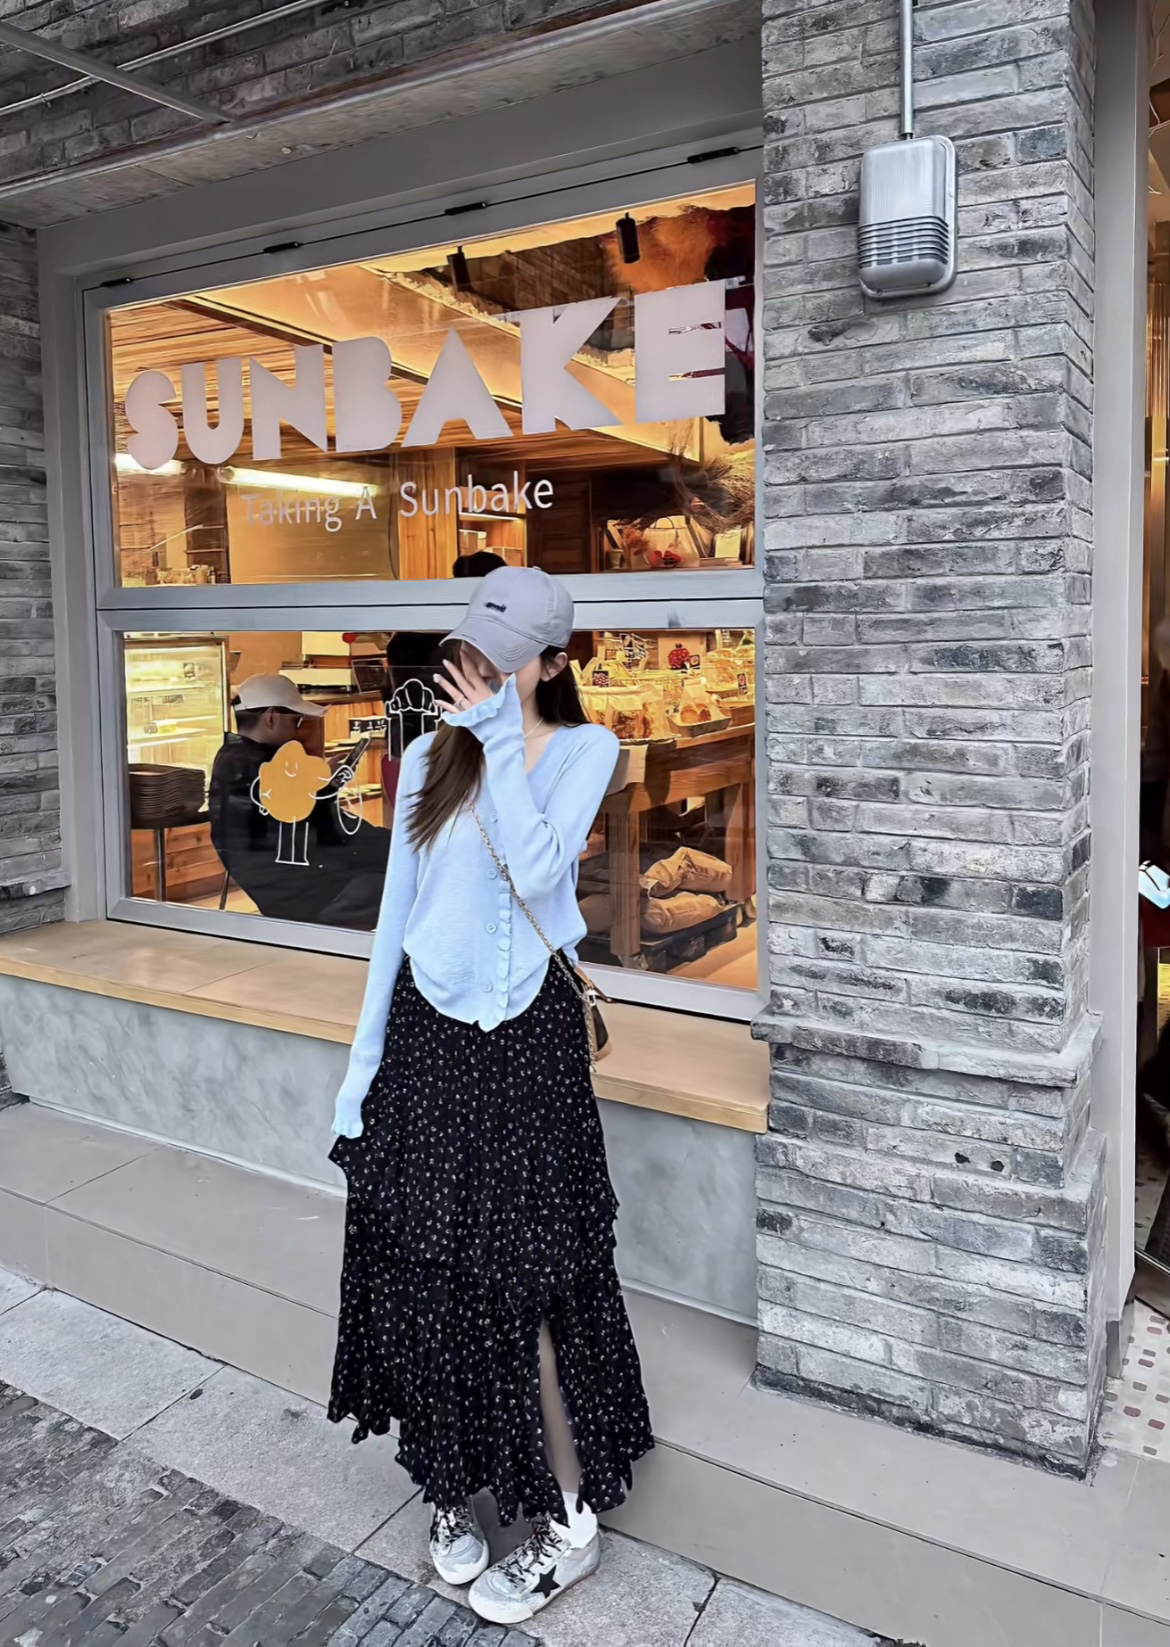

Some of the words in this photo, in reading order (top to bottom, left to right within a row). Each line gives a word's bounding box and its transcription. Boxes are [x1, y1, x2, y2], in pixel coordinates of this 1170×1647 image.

[124, 279, 726, 470] SUNBAKE
[240, 488, 343, 533] Taking
[355, 486, 378, 520] A
[400, 470, 554, 518] Sunbake
